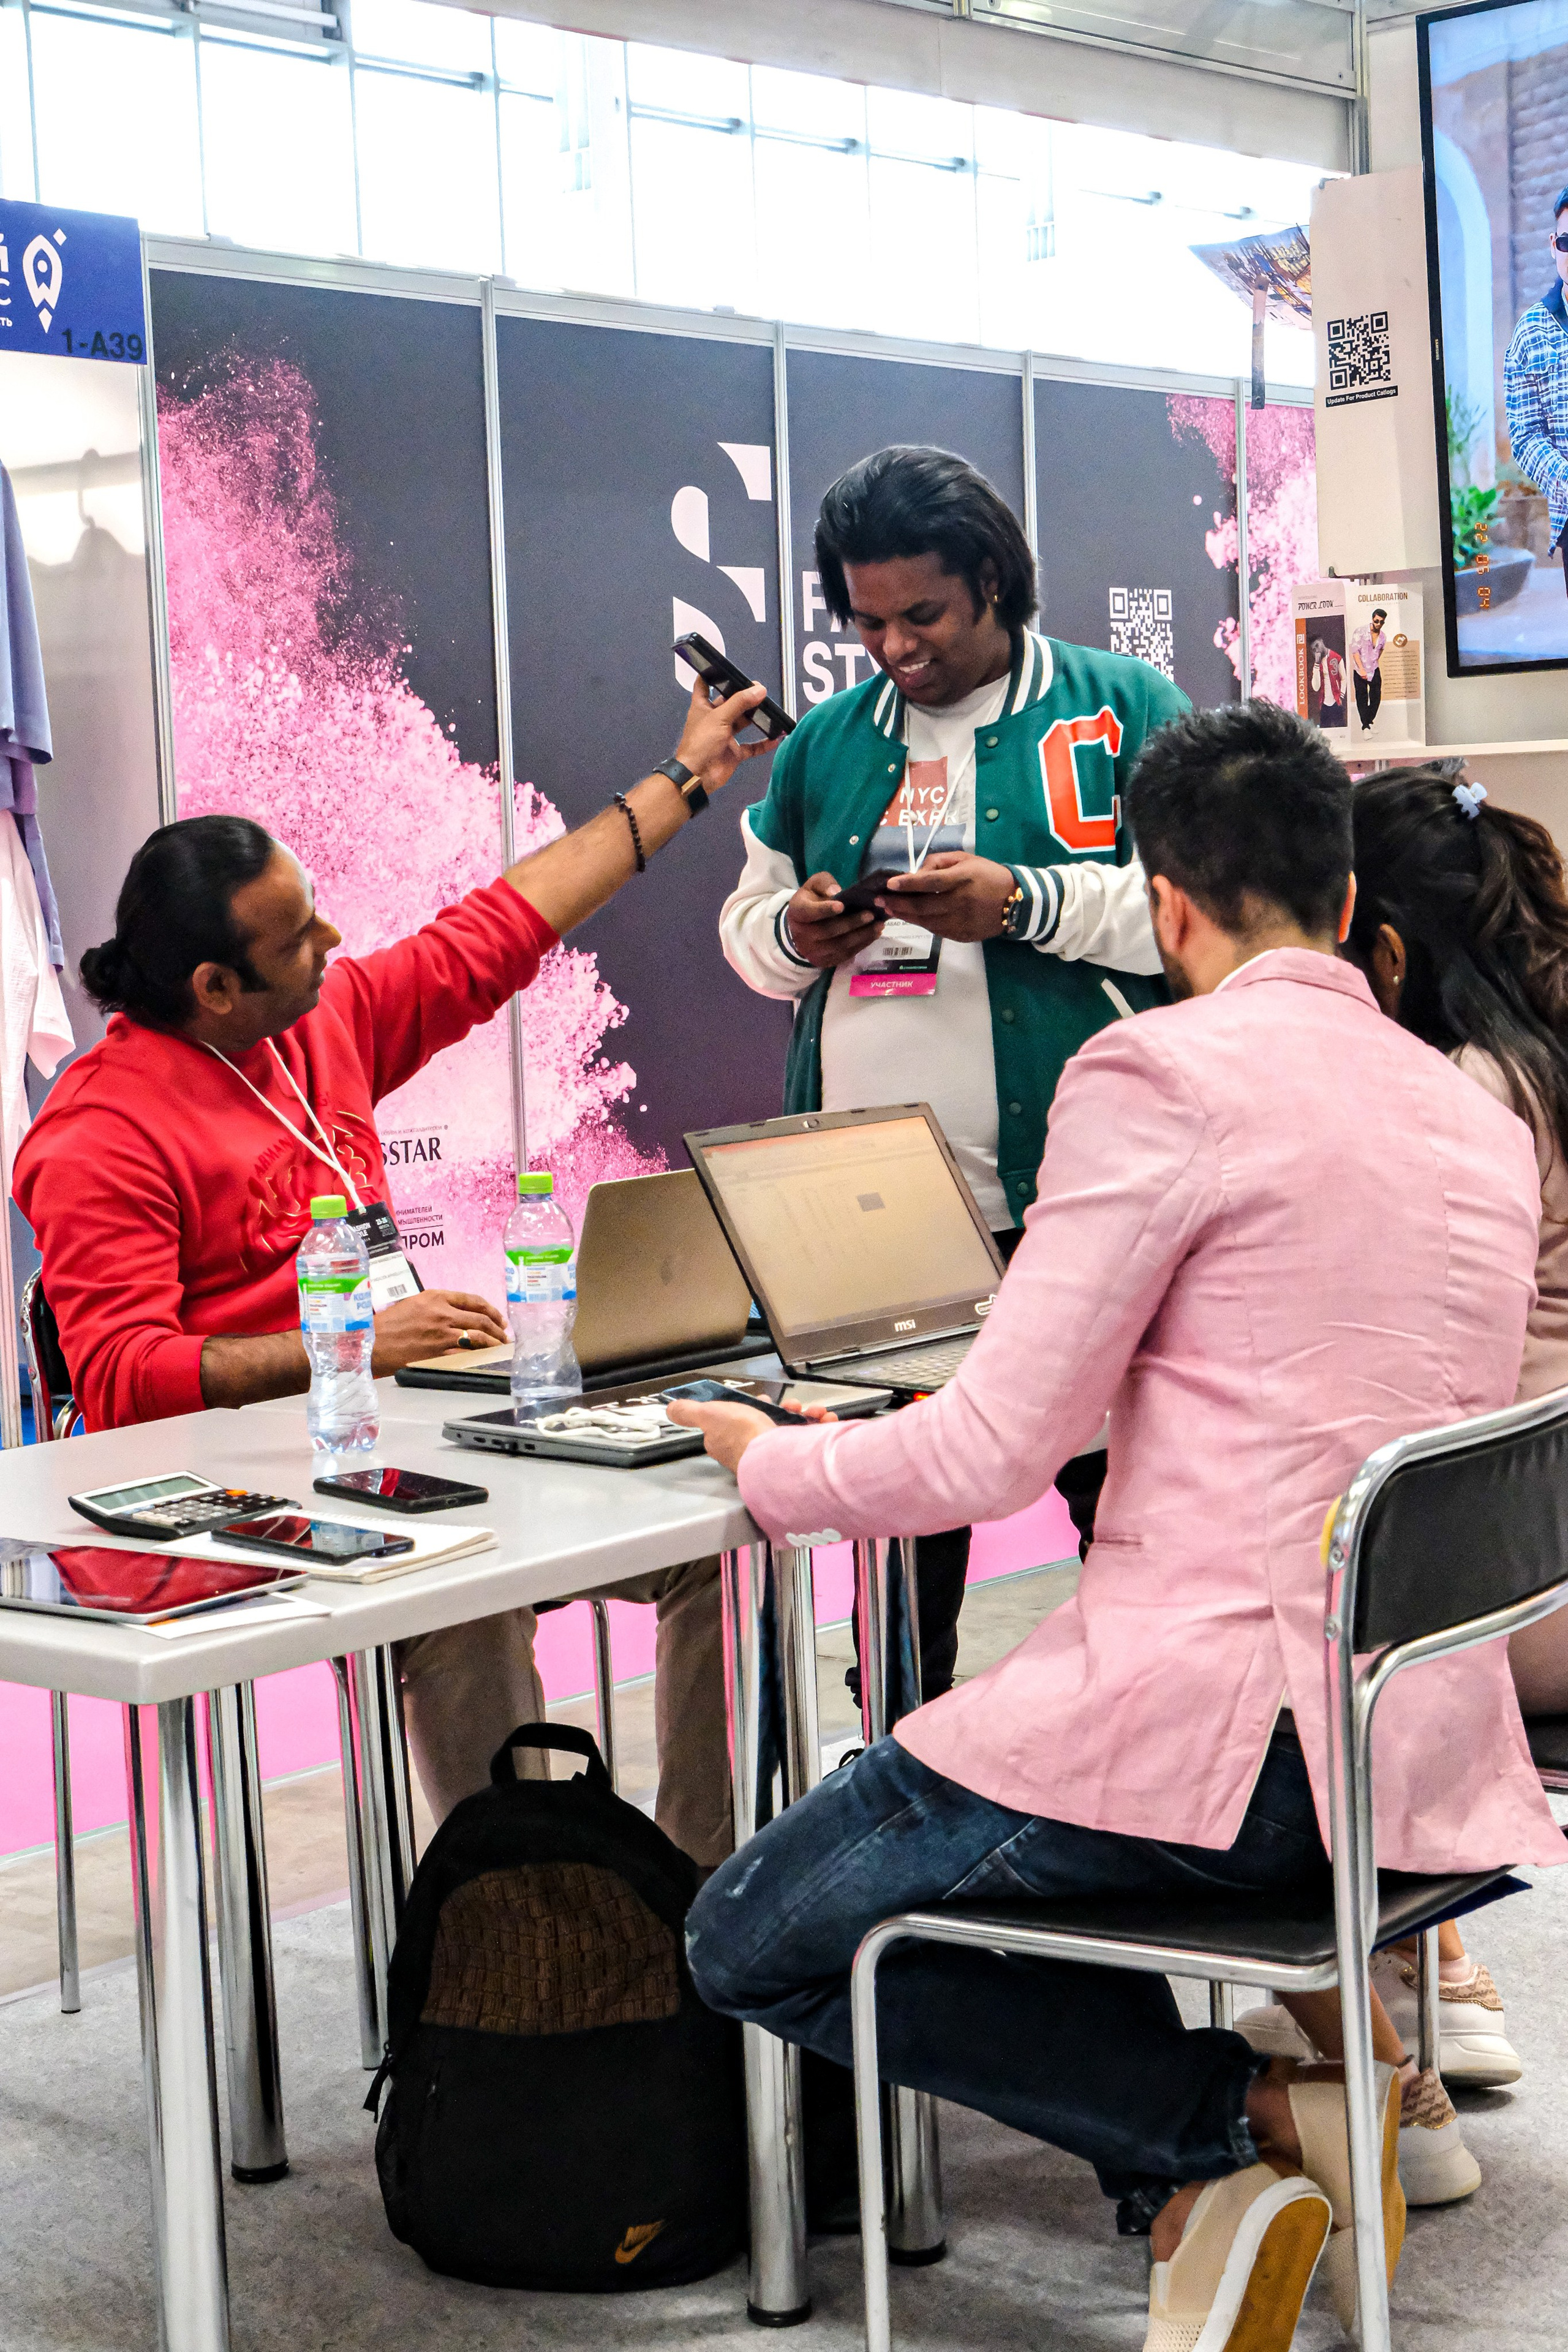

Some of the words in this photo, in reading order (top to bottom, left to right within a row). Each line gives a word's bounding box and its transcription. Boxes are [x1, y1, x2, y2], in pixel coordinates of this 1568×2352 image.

[62, 328, 143, 360] 1-A39
[1358, 592, 1408, 603] COLLABORATION
[1477, 586, 1491, 609] 04
[802, 641, 882, 705] ST
[1038, 705, 1124, 854] C
[899, 786, 945, 804] NYC
[894, 1319, 916, 1333] msi
